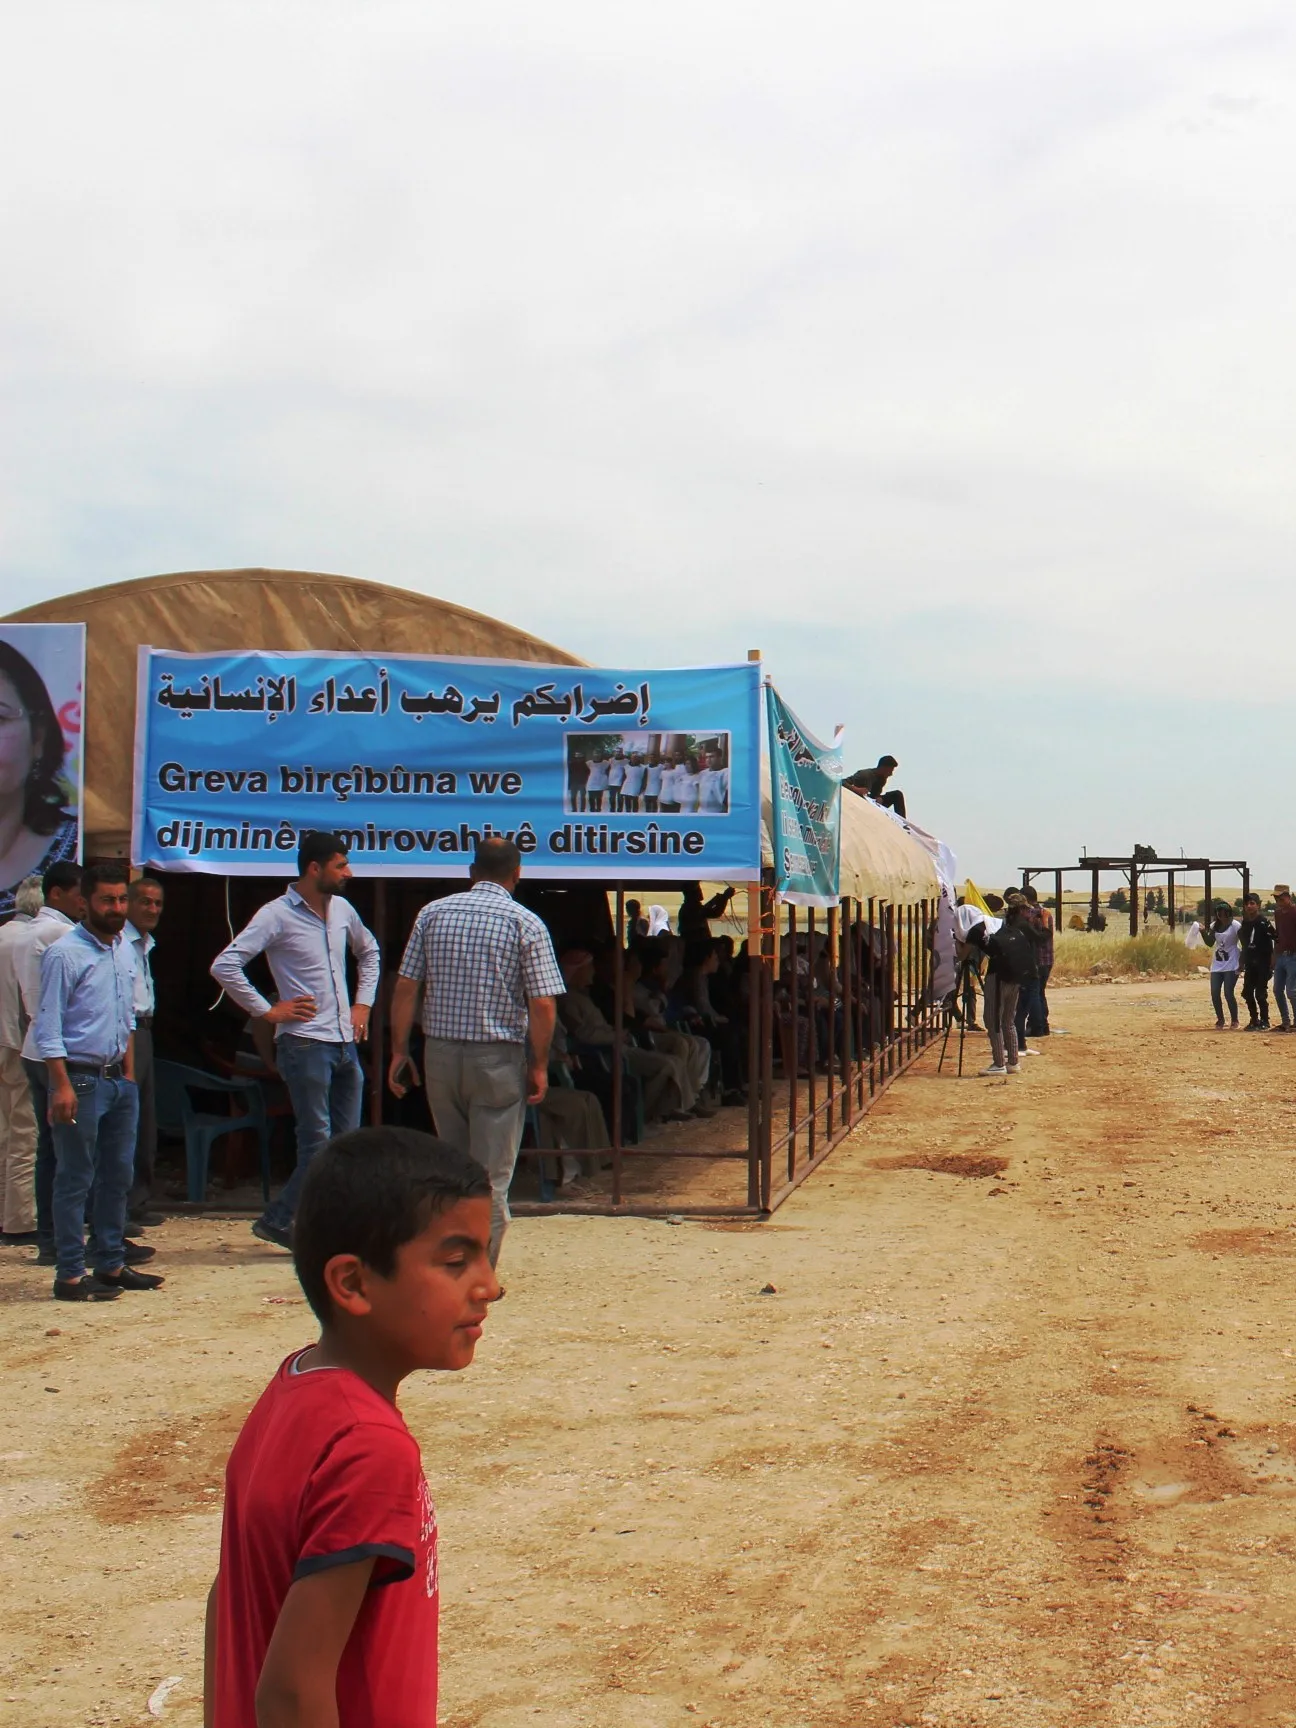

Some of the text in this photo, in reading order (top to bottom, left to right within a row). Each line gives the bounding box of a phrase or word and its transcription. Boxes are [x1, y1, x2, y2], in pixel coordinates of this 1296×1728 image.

[157, 667, 651, 727] إضرابكم يرهب أعداء الإنسانية
[158, 761, 522, 803] Greva birçîbûna we
[547, 821, 705, 855] ditirsîne
